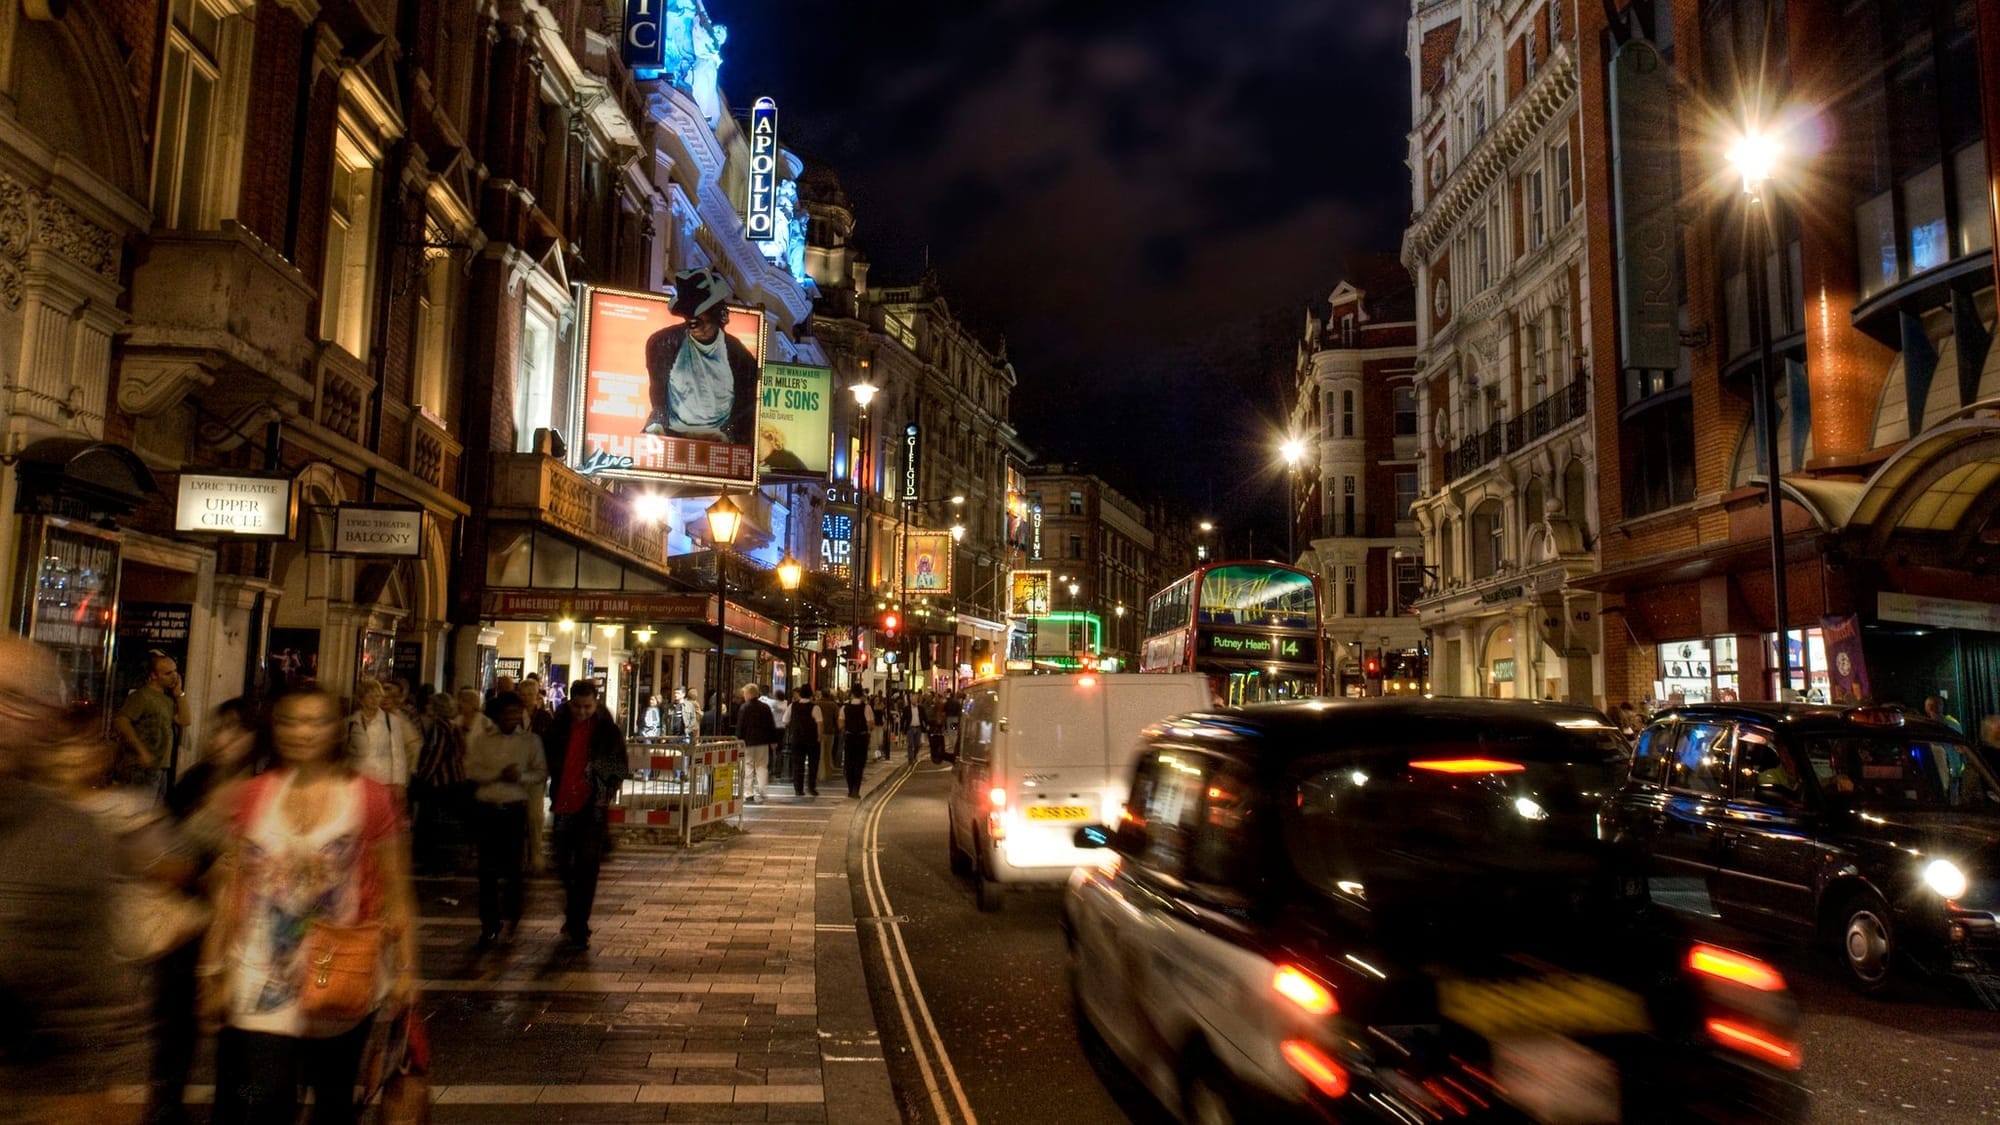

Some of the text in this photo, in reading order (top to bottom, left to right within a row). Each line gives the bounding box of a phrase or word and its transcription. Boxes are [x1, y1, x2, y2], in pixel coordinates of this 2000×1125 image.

[750, 116, 773, 232] APOLLO
[775, 377, 808, 389] MILLER'S
[763, 388, 819, 411] MY SONS
[583, 448, 633, 474] Live
[587, 432, 752, 476] THRILLER
[906, 436, 916, 496] GIELGUD
[190, 480, 278, 494] LYRIC THEATRE
[205, 498, 260, 512] UPPER
[201, 513, 262, 528] CIRCLE
[346, 518, 411, 529] LYRIC THEATRE
[345, 532, 410, 544] BALCONY
[1033, 513, 1042, 558] QUEENS
[508, 597, 561, 611] DANGEROUS
[575, 599, 600, 612] DIRTY
[602, 600, 629, 613] DIANA
[631, 602, 647, 614] plus
[649, 603, 674, 616] many
[1213, 636, 1299, 656] Putney Heath 14
